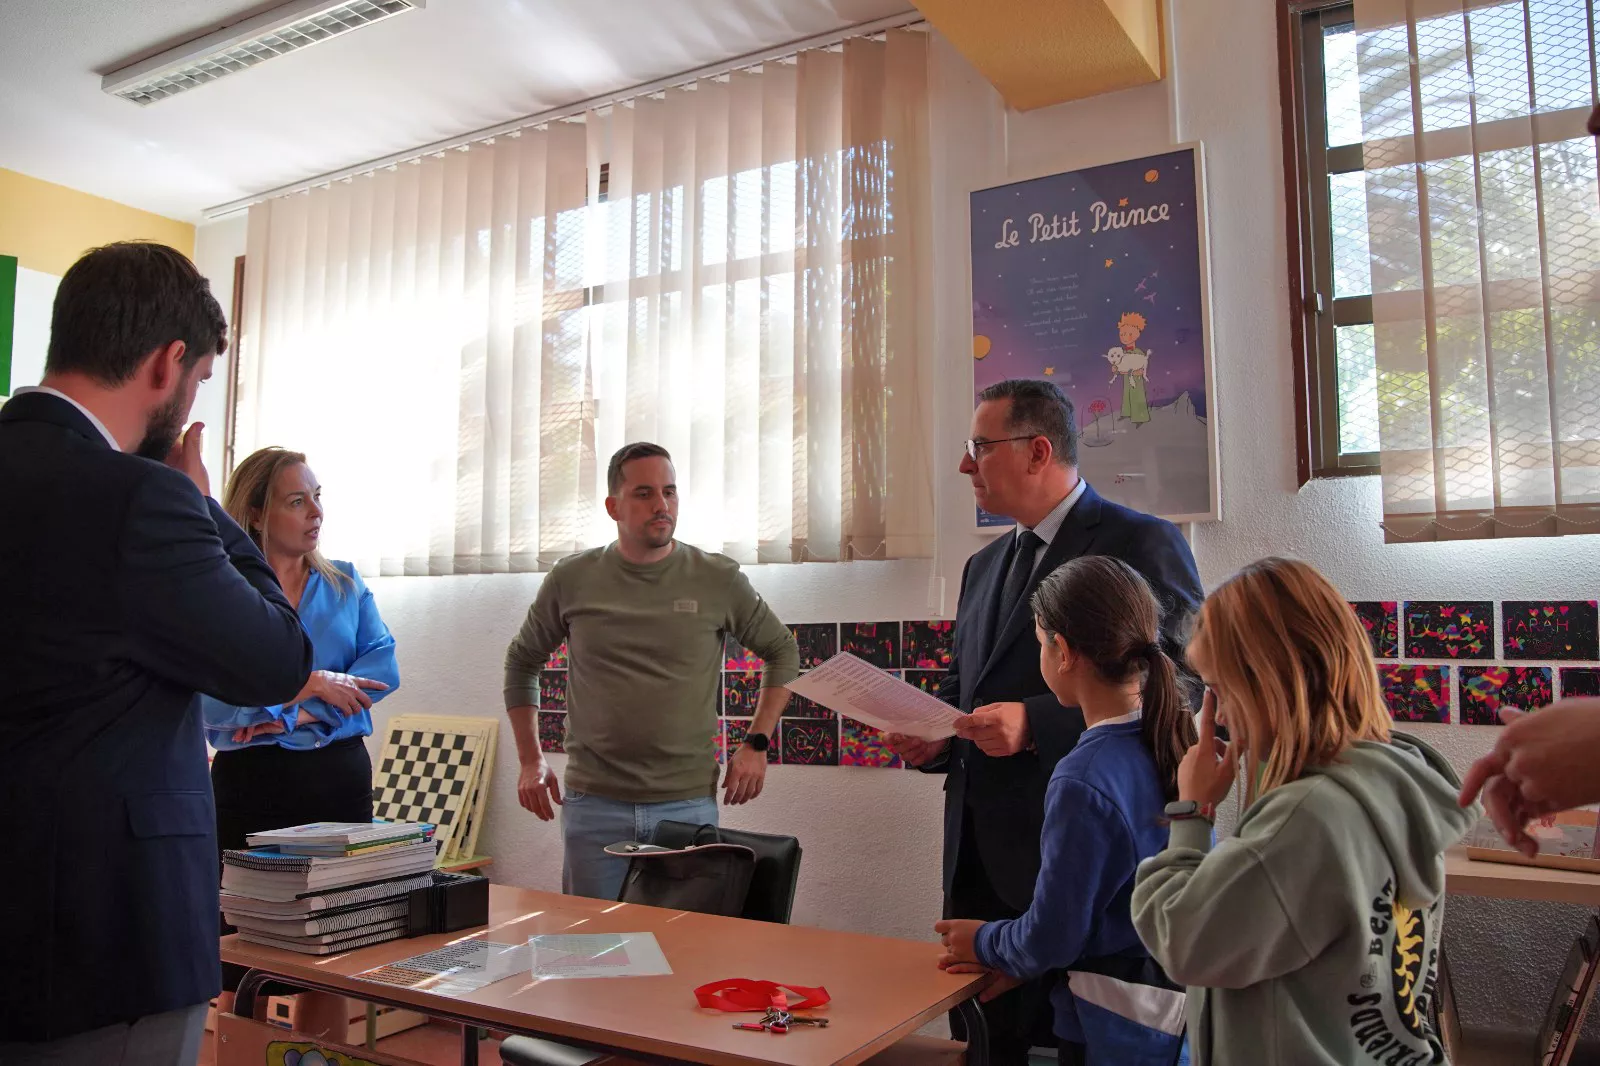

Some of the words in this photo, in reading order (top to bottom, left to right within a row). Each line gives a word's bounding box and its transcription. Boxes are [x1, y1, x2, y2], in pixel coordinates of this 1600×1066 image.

[994, 218, 1020, 249] Le
[1028, 210, 1081, 243] Petit
[1089, 200, 1170, 233] Prince
